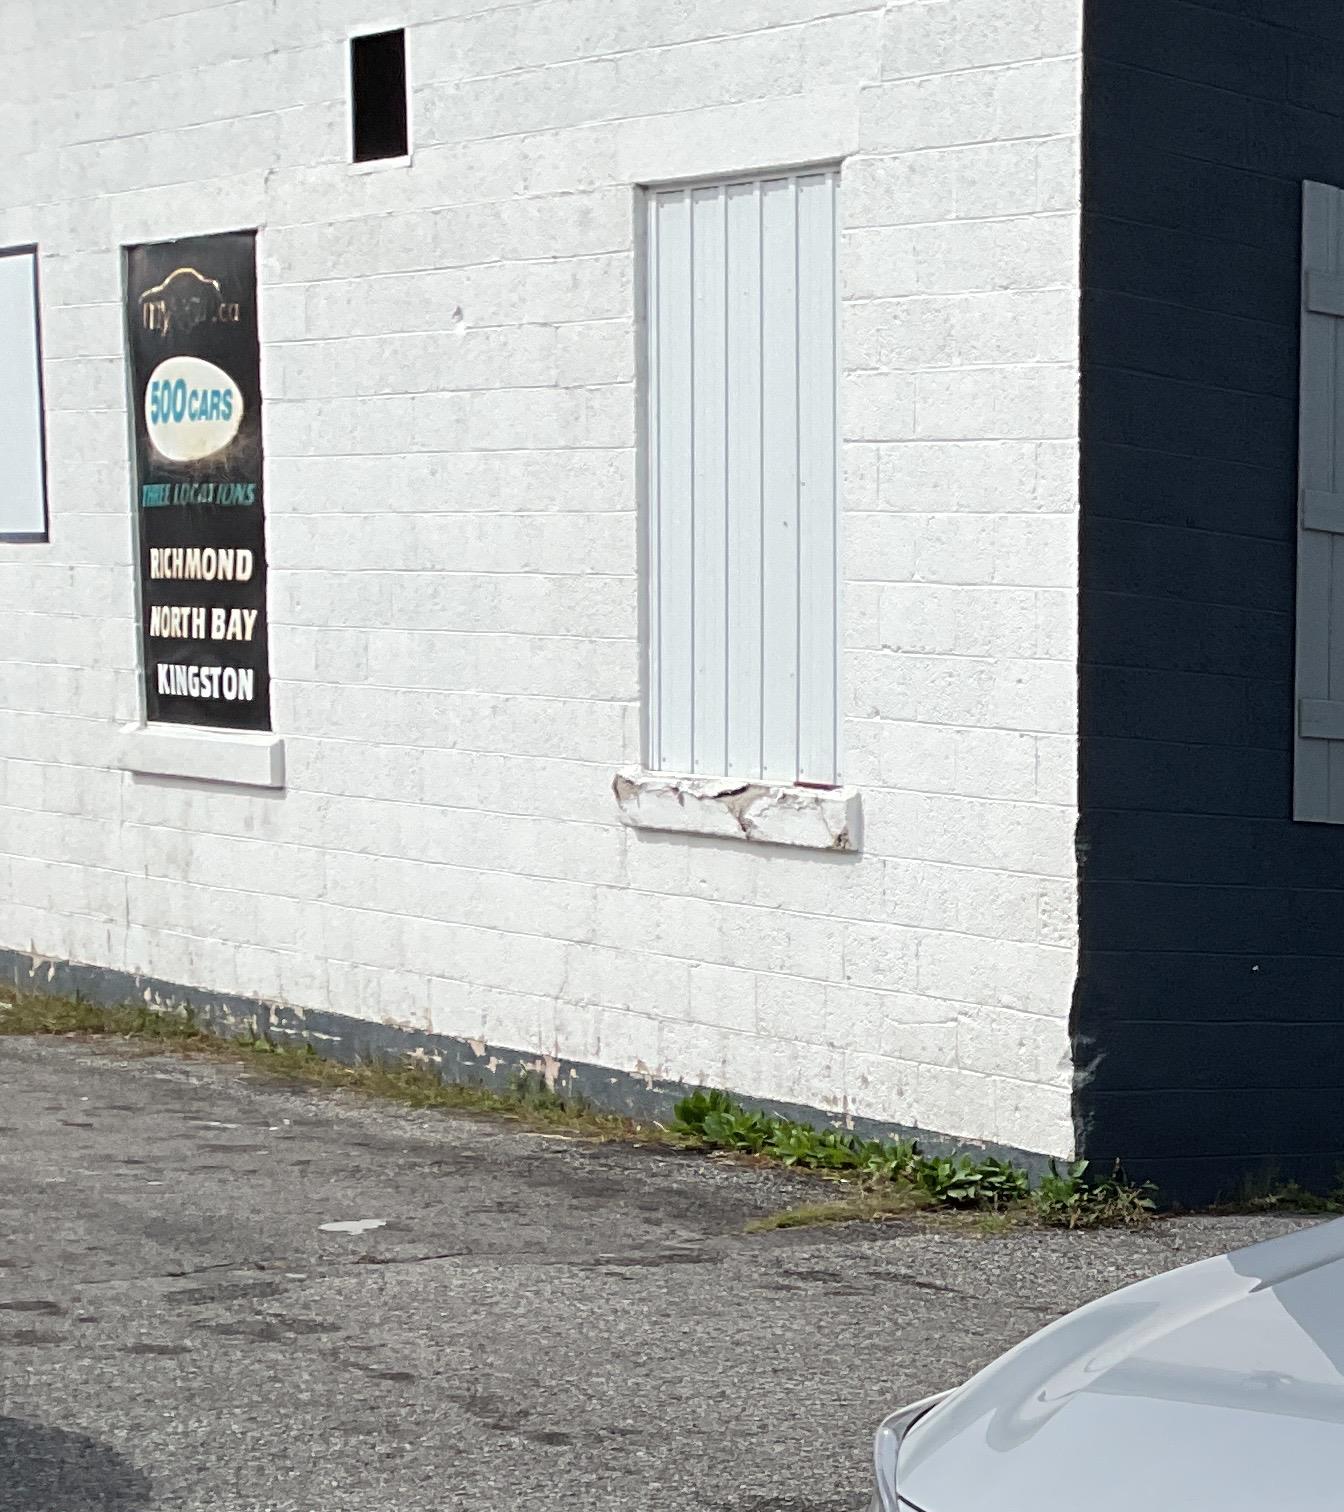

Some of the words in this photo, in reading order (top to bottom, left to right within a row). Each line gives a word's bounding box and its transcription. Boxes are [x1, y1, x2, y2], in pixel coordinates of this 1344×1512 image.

[150, 548, 253, 582] RICHMOND
[150, 605, 206, 640] NORTH
[211, 607, 258, 641] BAY
[157, 663, 254, 701] KINGSTON
